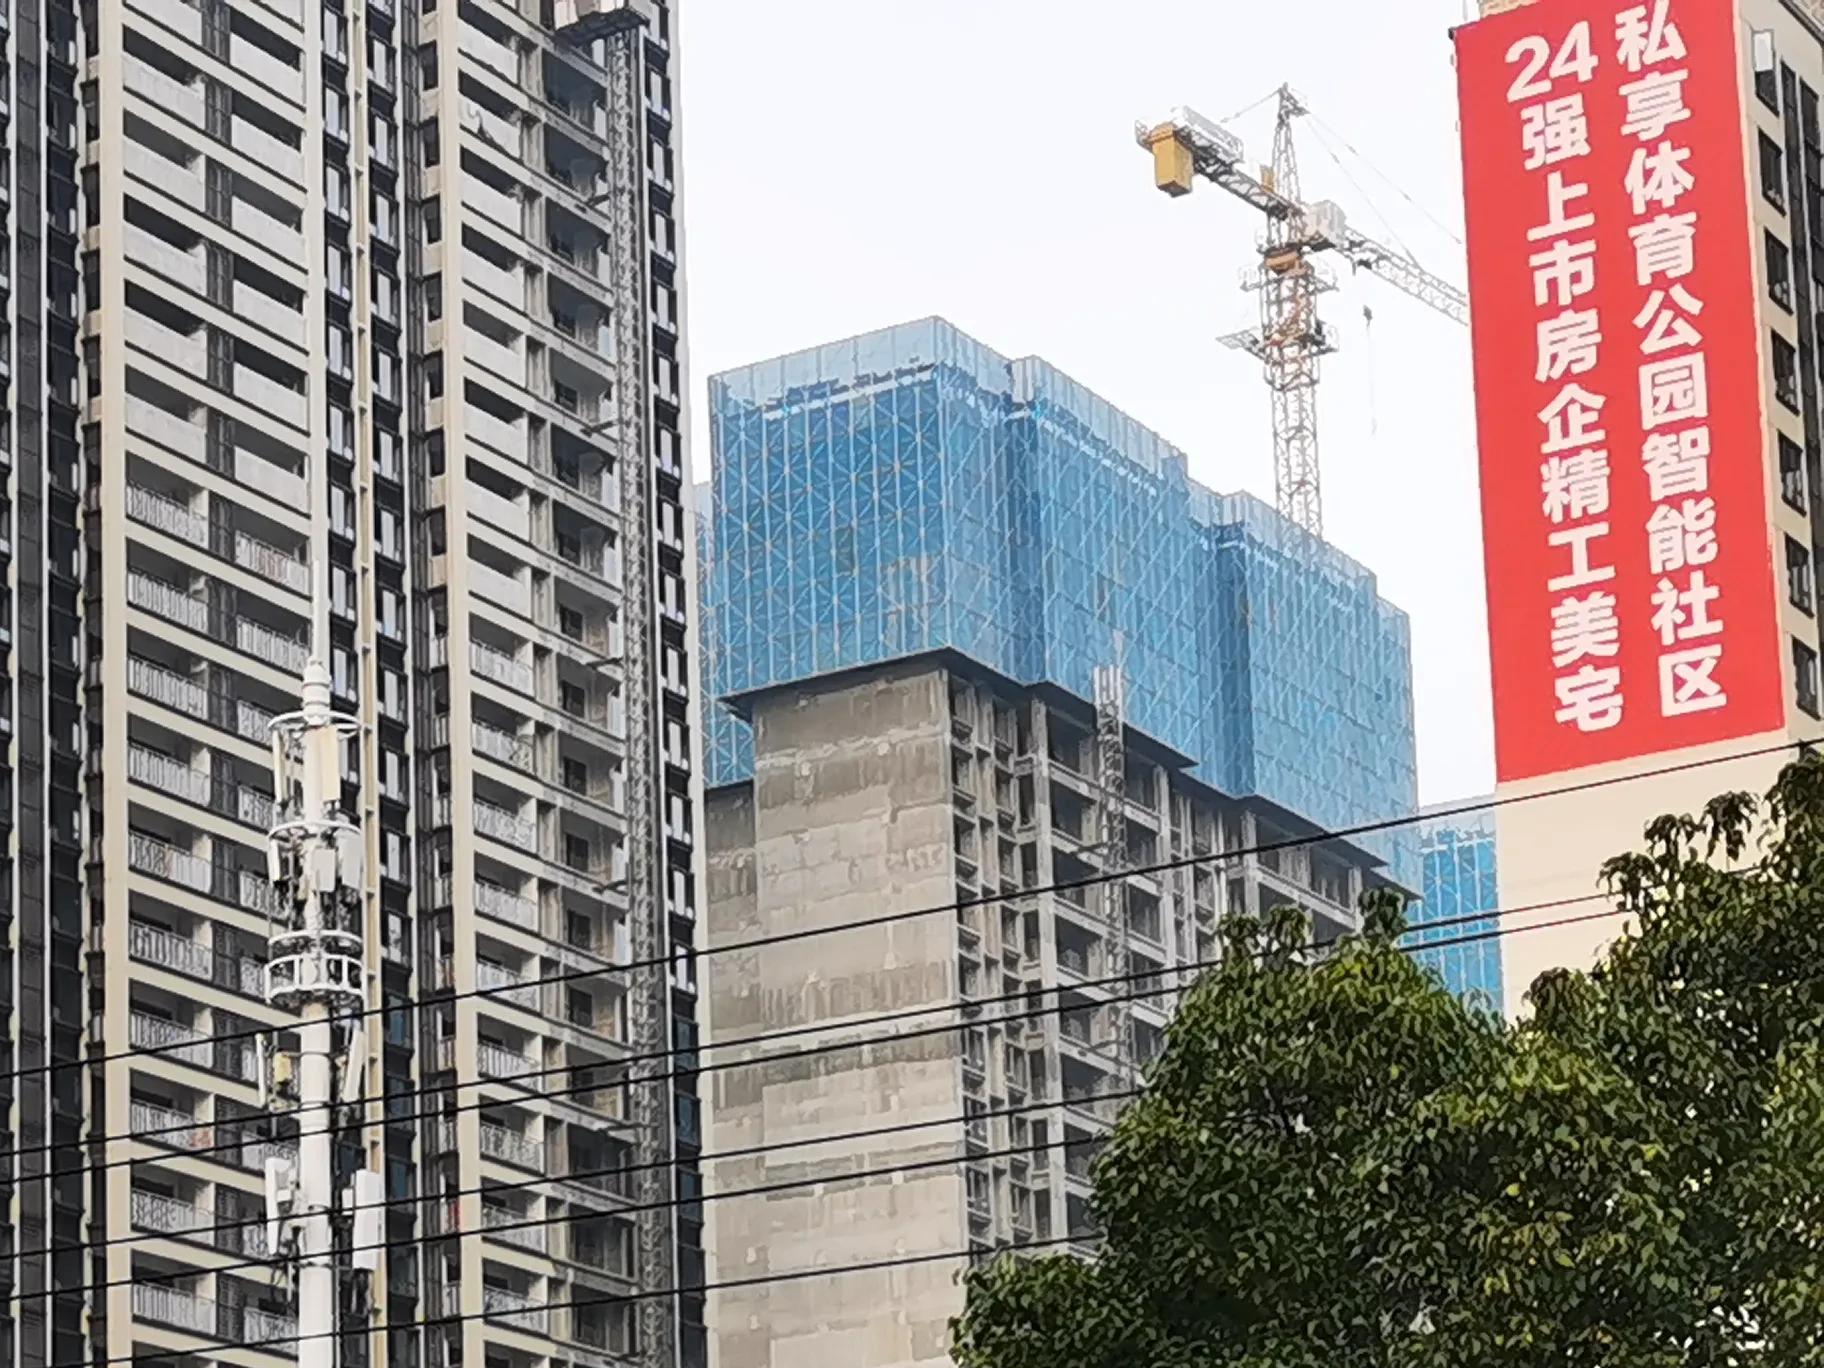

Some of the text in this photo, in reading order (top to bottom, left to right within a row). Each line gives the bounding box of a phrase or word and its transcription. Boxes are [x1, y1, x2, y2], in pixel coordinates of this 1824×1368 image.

[1504, 21, 1623, 732] 24强上市房企精工美宅
[1615, 0, 1727, 717] 私享体育公园智能社区
